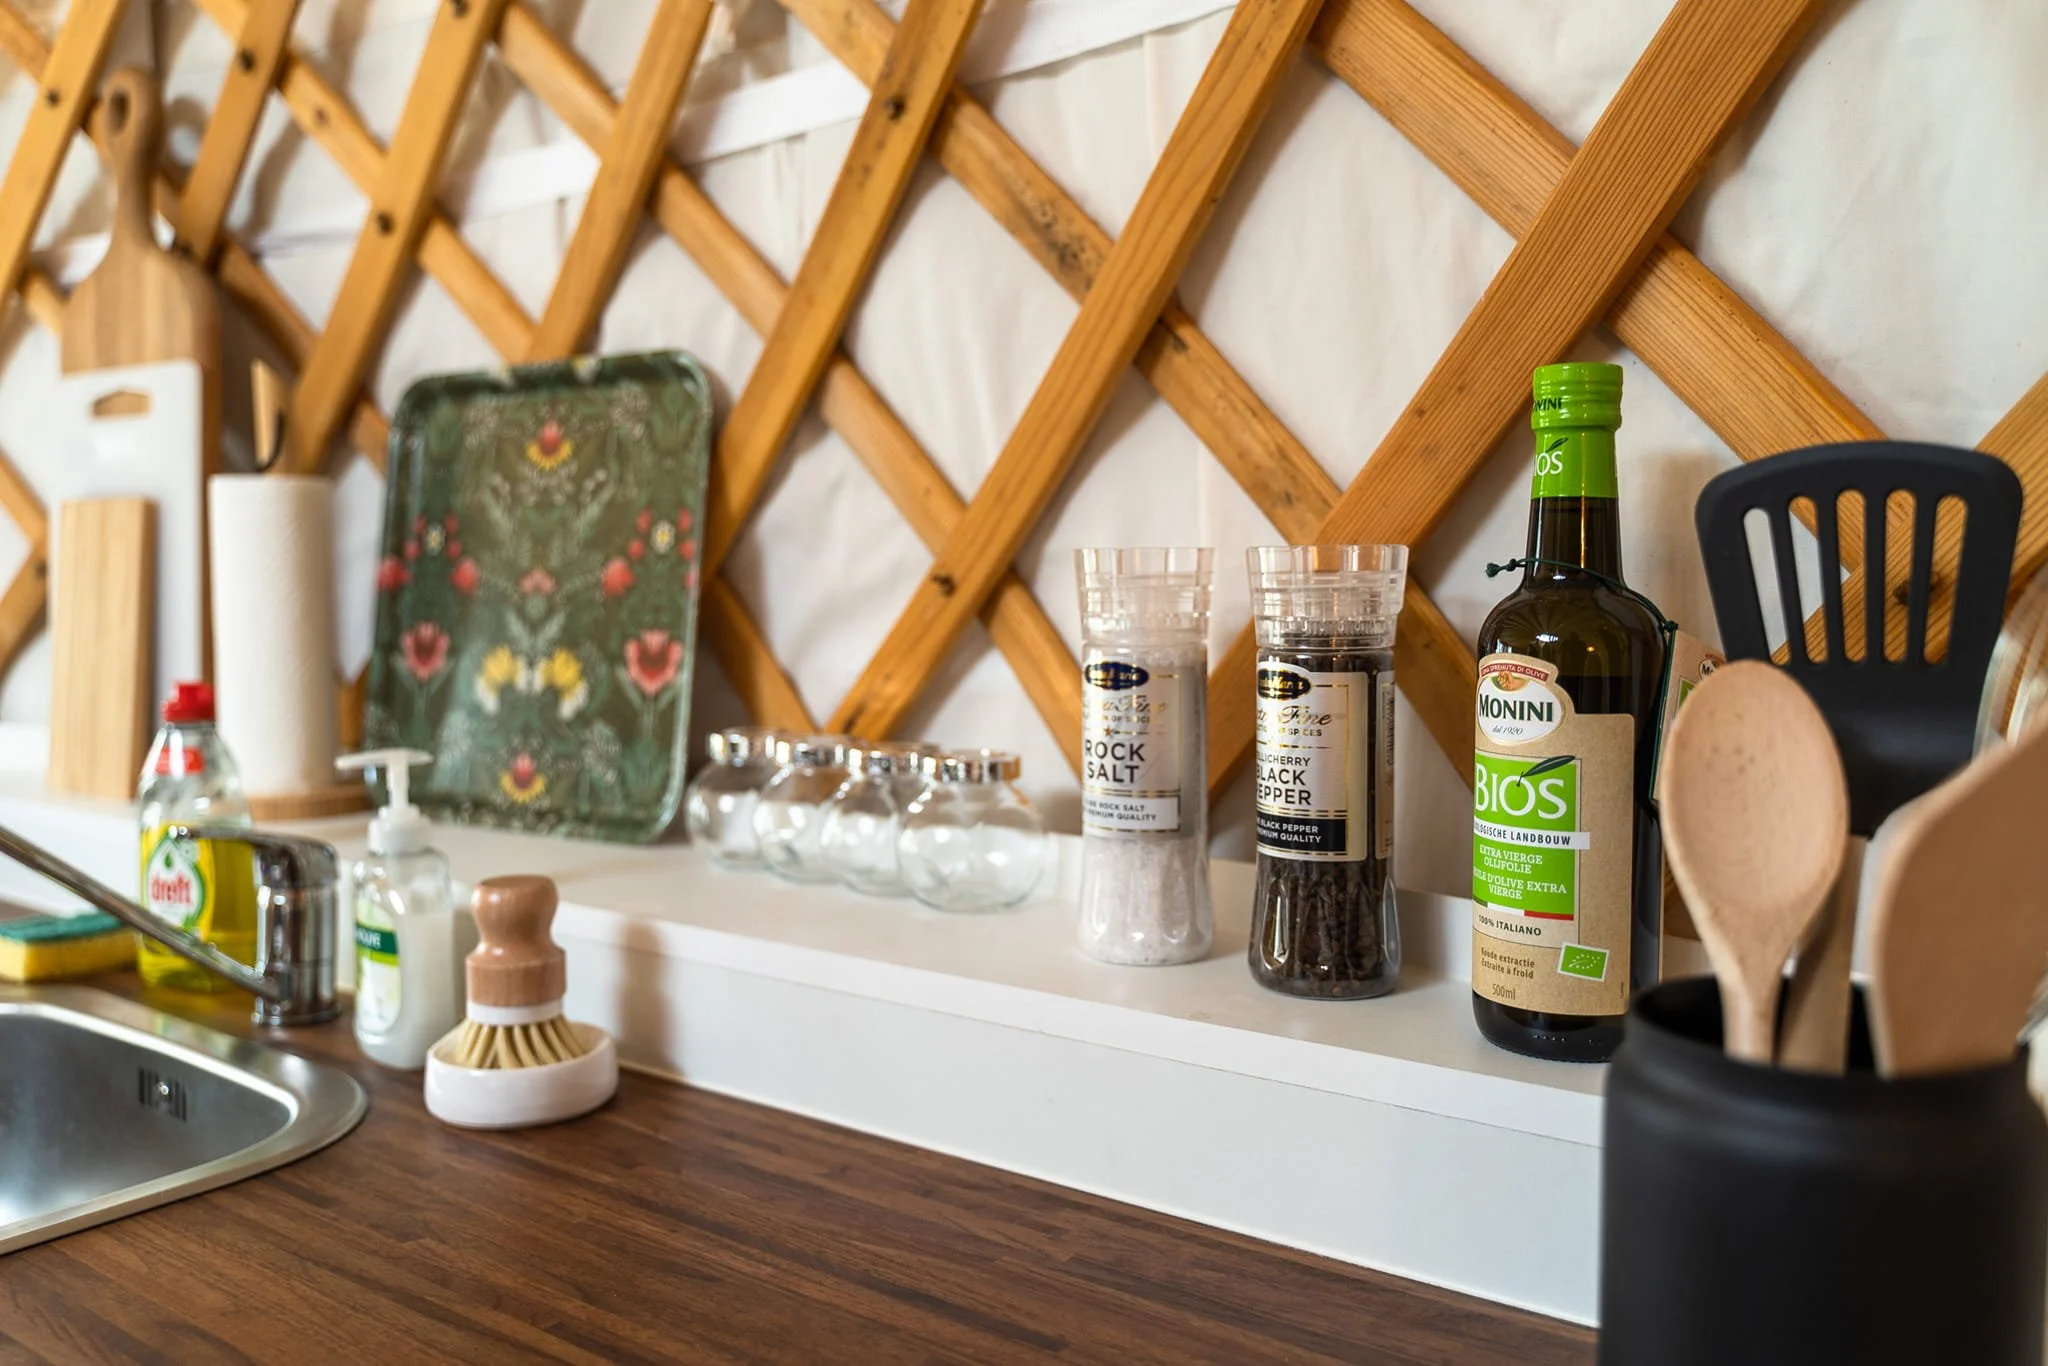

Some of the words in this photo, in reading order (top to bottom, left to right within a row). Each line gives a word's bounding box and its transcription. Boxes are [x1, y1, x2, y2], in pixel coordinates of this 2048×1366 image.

[1525, 668, 1546, 680] OLIVE
[1479, 693, 1553, 722] MONINI
[1502, 726, 1525, 736] 1920
[1085, 739, 1146, 762] ROCK
[1087, 761, 1140, 784] SALT
[1475, 763, 1567, 819] BIOS
[1099, 801, 1120, 811] ROCK
[1123, 804, 1145, 813] SALT
[1116, 811, 1157, 822] QUALITY
[1282, 823, 1319, 834] PEPPER
[1280, 832, 1321, 844] QUALITY
[1510, 831, 1571, 846] LANDBOUW
[1480, 845, 1502, 859] EXTRA
[1503, 850, 1543, 865] VIERGE
[151, 874, 191, 904] dreft
[1488, 873, 1524, 889] D'OLIVE
[1526, 881, 1568, 894] EXTRA
[1489, 884, 1523, 900] VIERGE
[1478, 914, 1495, 928] 100%
[1496, 920, 1542, 936] ITALIANO
[1481, 957, 1505, 973] Extraite
[1513, 966, 1534, 979] froid
[1499, 955, 1536, 968] extractie
[1492, 983, 1516, 1000] 500ml
